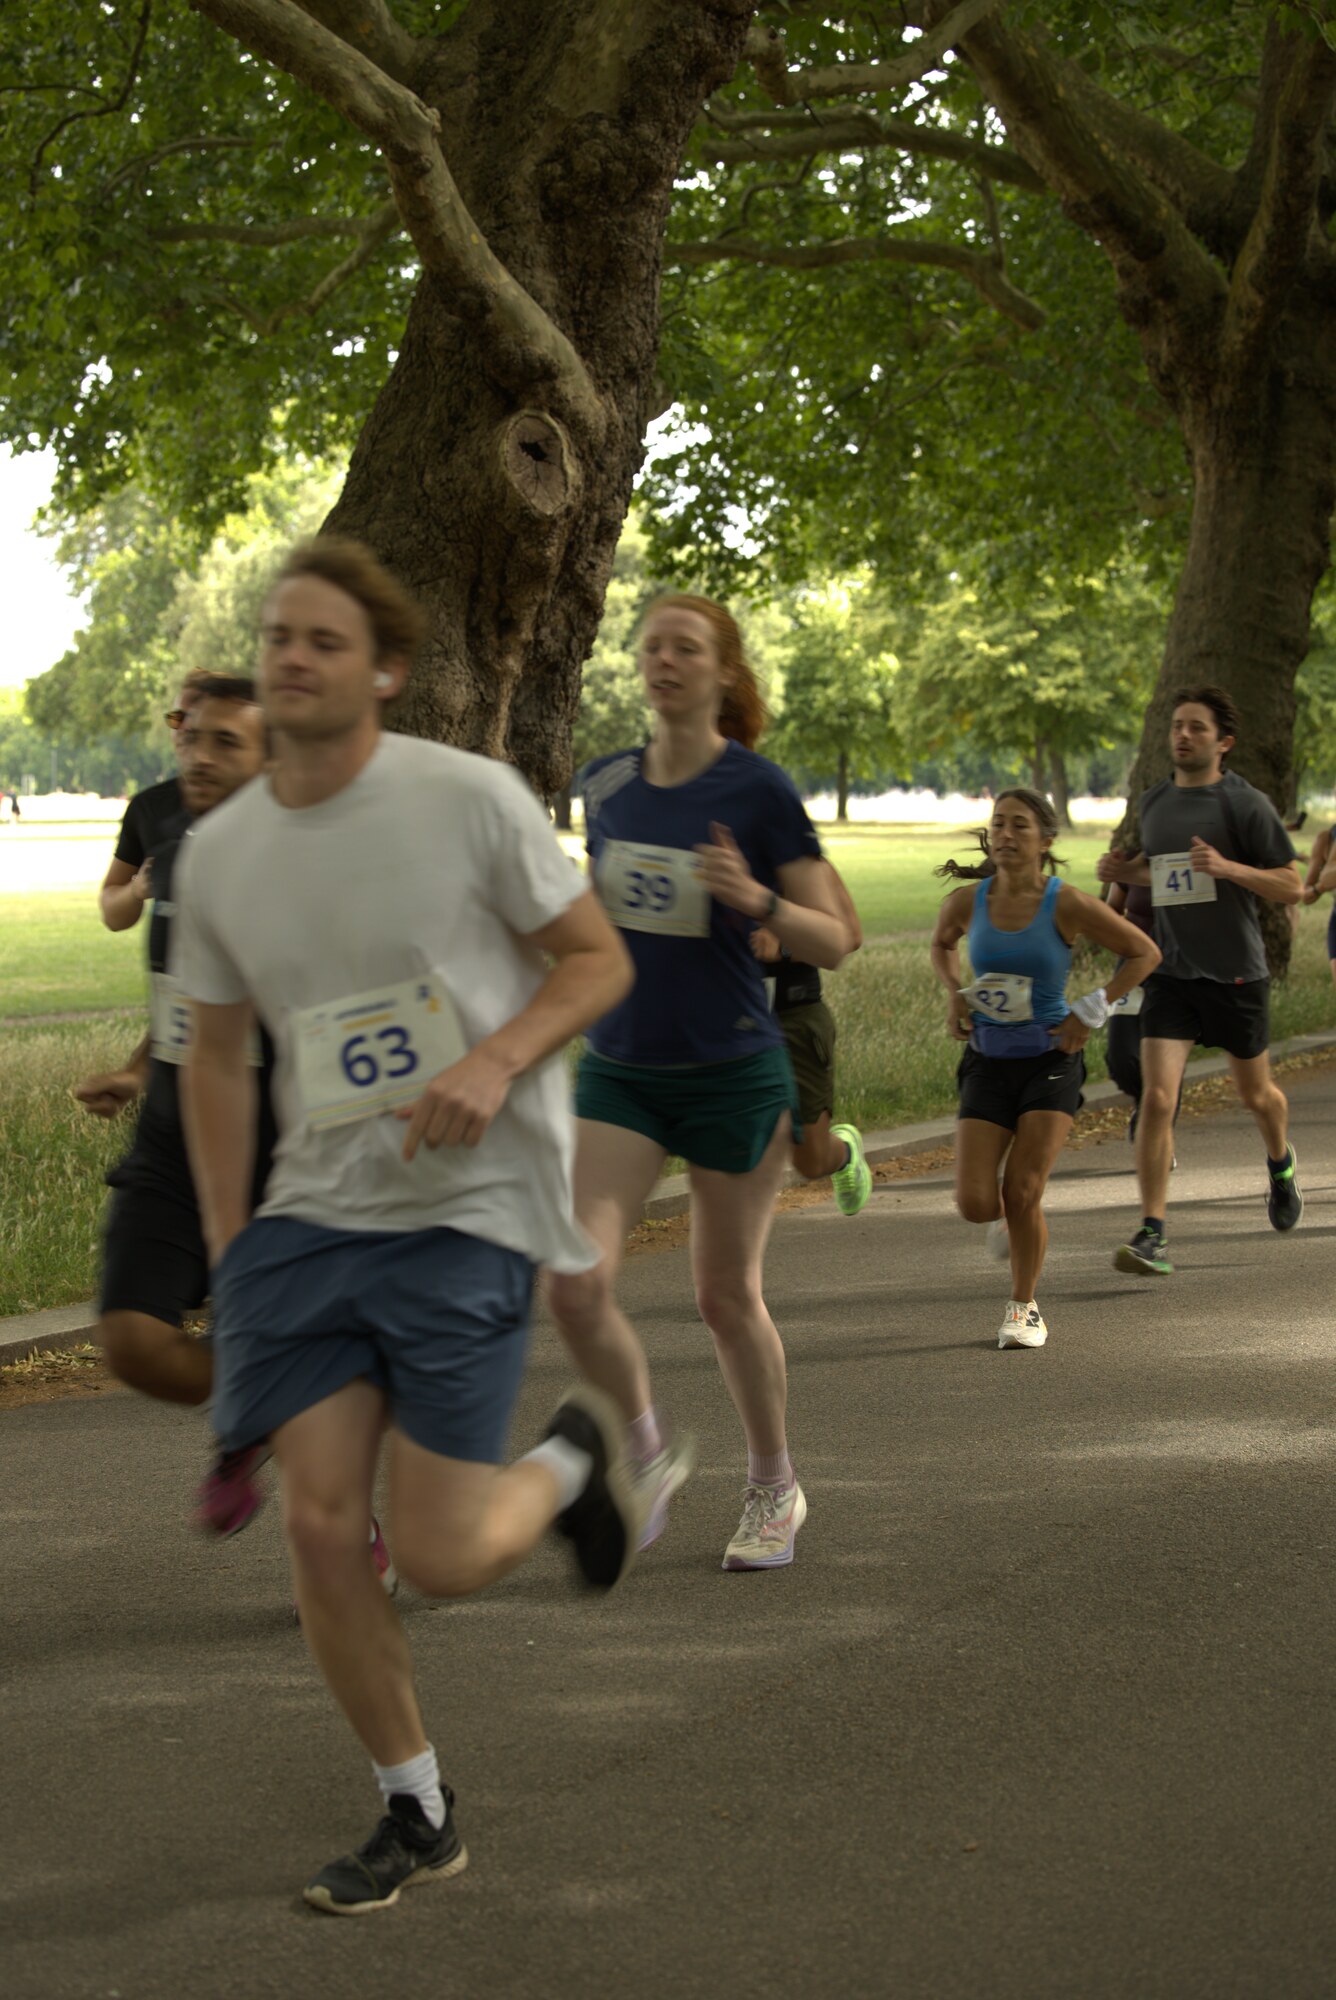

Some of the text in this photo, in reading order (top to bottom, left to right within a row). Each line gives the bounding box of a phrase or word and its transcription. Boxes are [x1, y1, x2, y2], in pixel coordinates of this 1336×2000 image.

[624, 870, 676, 913] 39
[1166, 868, 1193, 892] 41
[340, 1026, 419, 1087] 63
